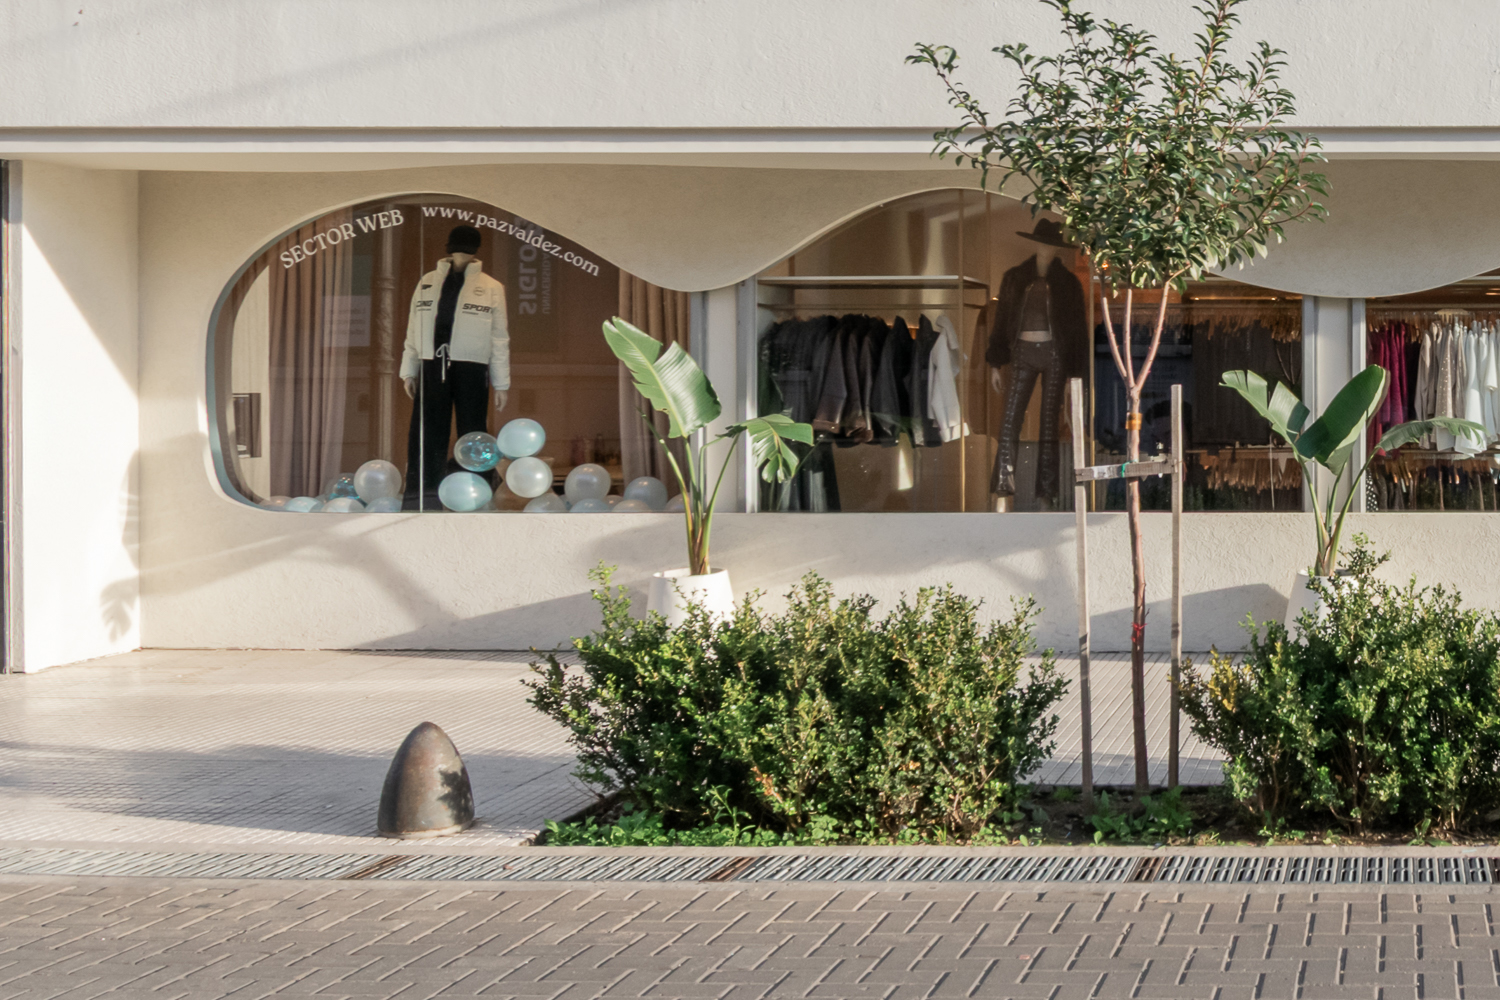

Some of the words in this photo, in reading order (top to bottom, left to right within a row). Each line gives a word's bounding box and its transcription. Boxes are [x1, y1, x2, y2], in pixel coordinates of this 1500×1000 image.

[279, 222, 357, 269] SECTOR
[355, 208, 405, 234] WEB
[421, 206, 601, 277] www.pazvaldez.com
